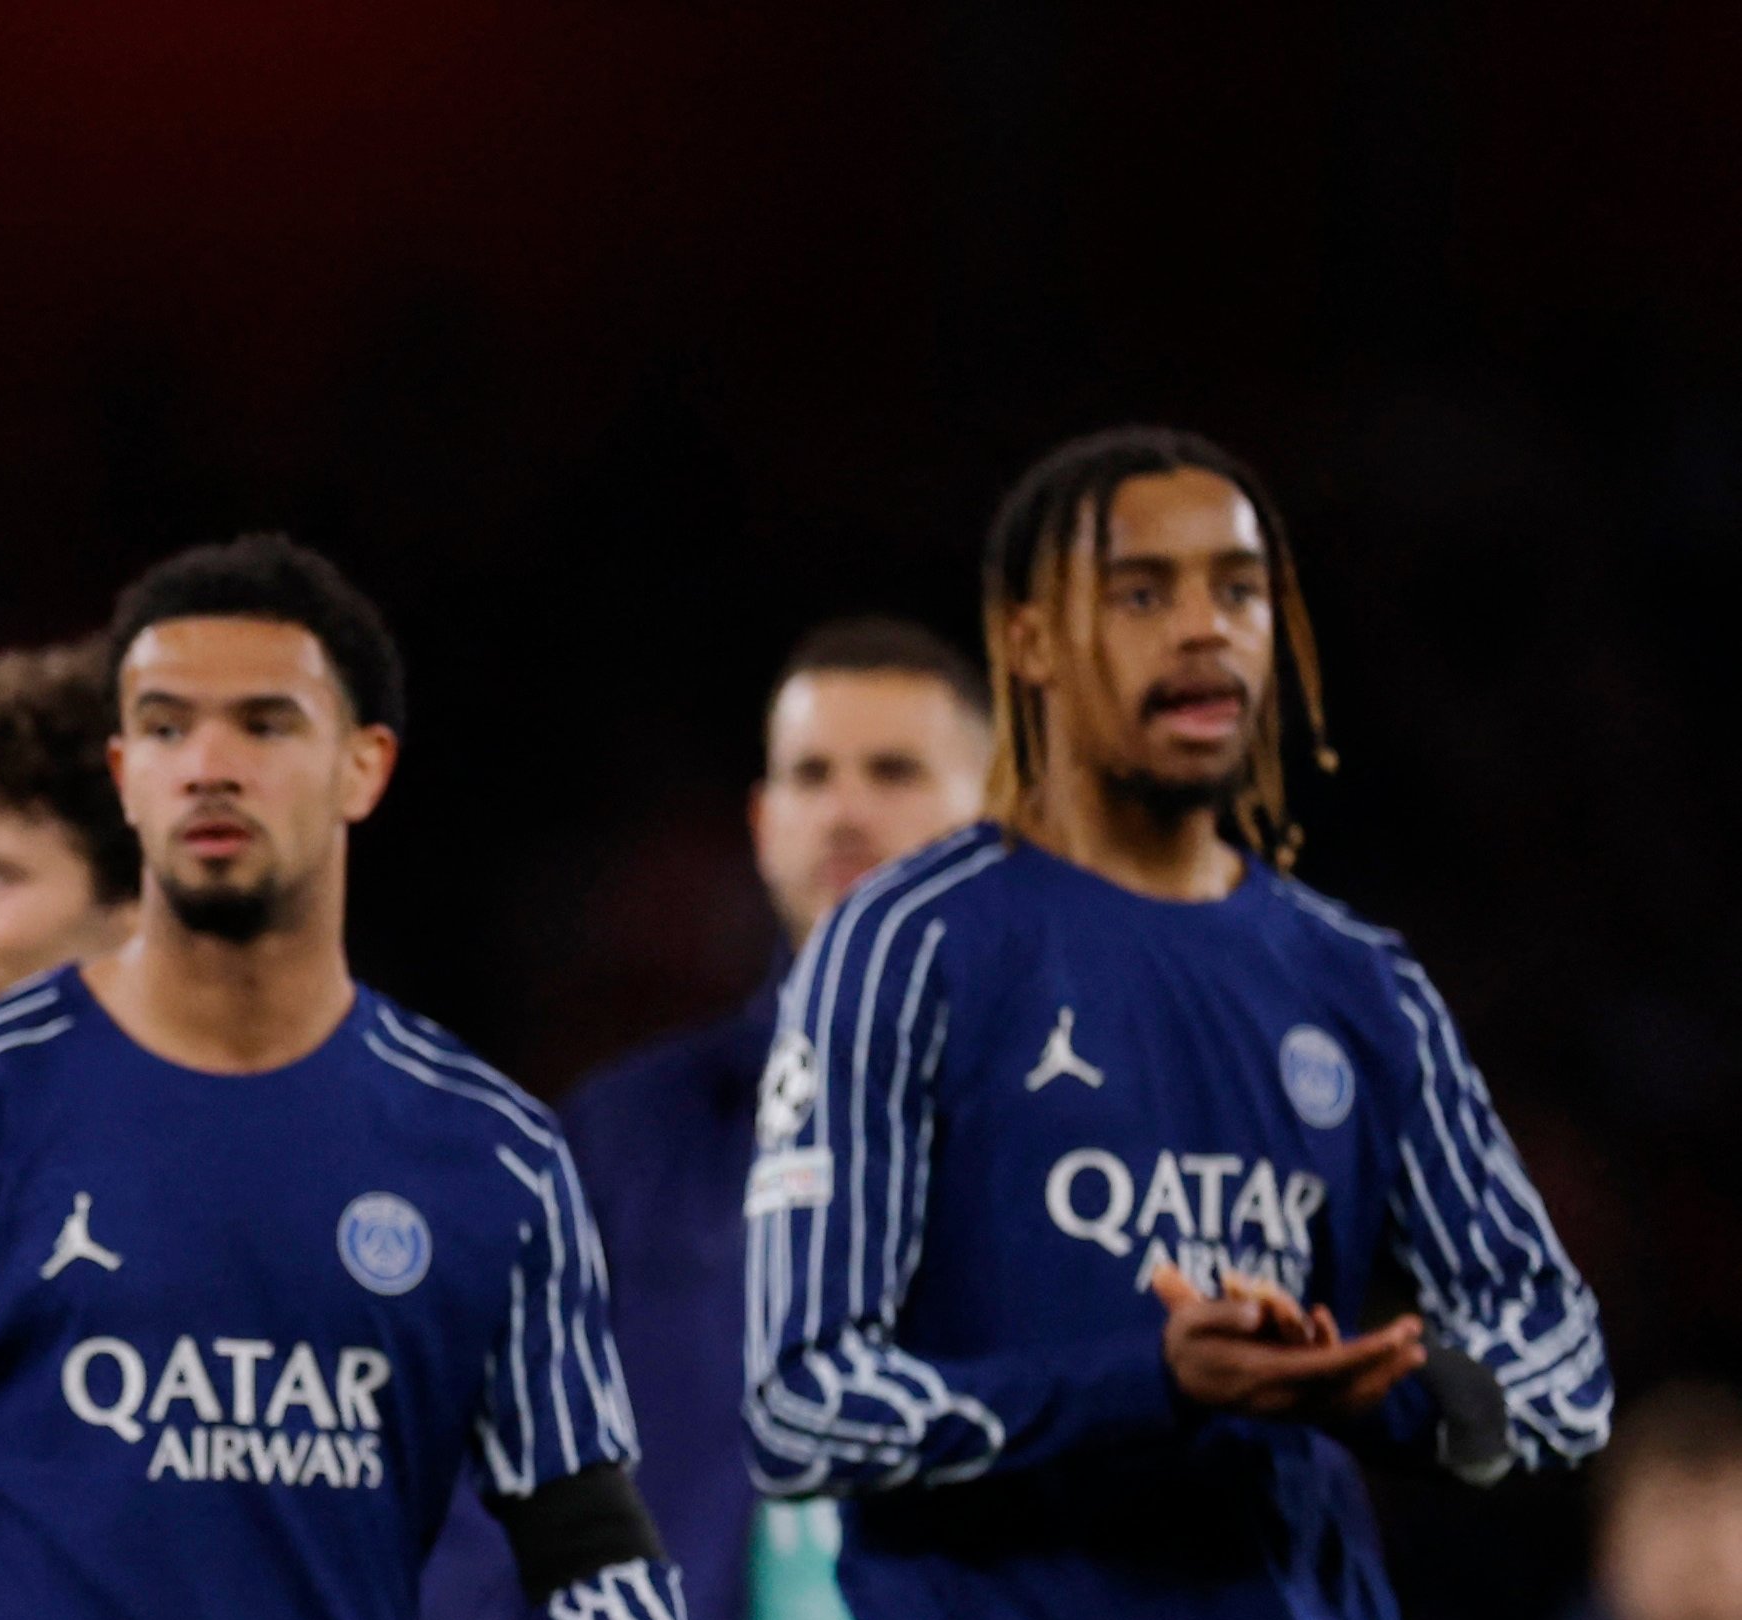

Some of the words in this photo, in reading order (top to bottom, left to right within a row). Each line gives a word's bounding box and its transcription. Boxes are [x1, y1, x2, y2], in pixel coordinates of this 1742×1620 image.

[1044, 1147, 1326, 1258] QATAR
[60, 1334, 391, 1444] QATAR
[146, 1424, 384, 1490] AIRWAYS
